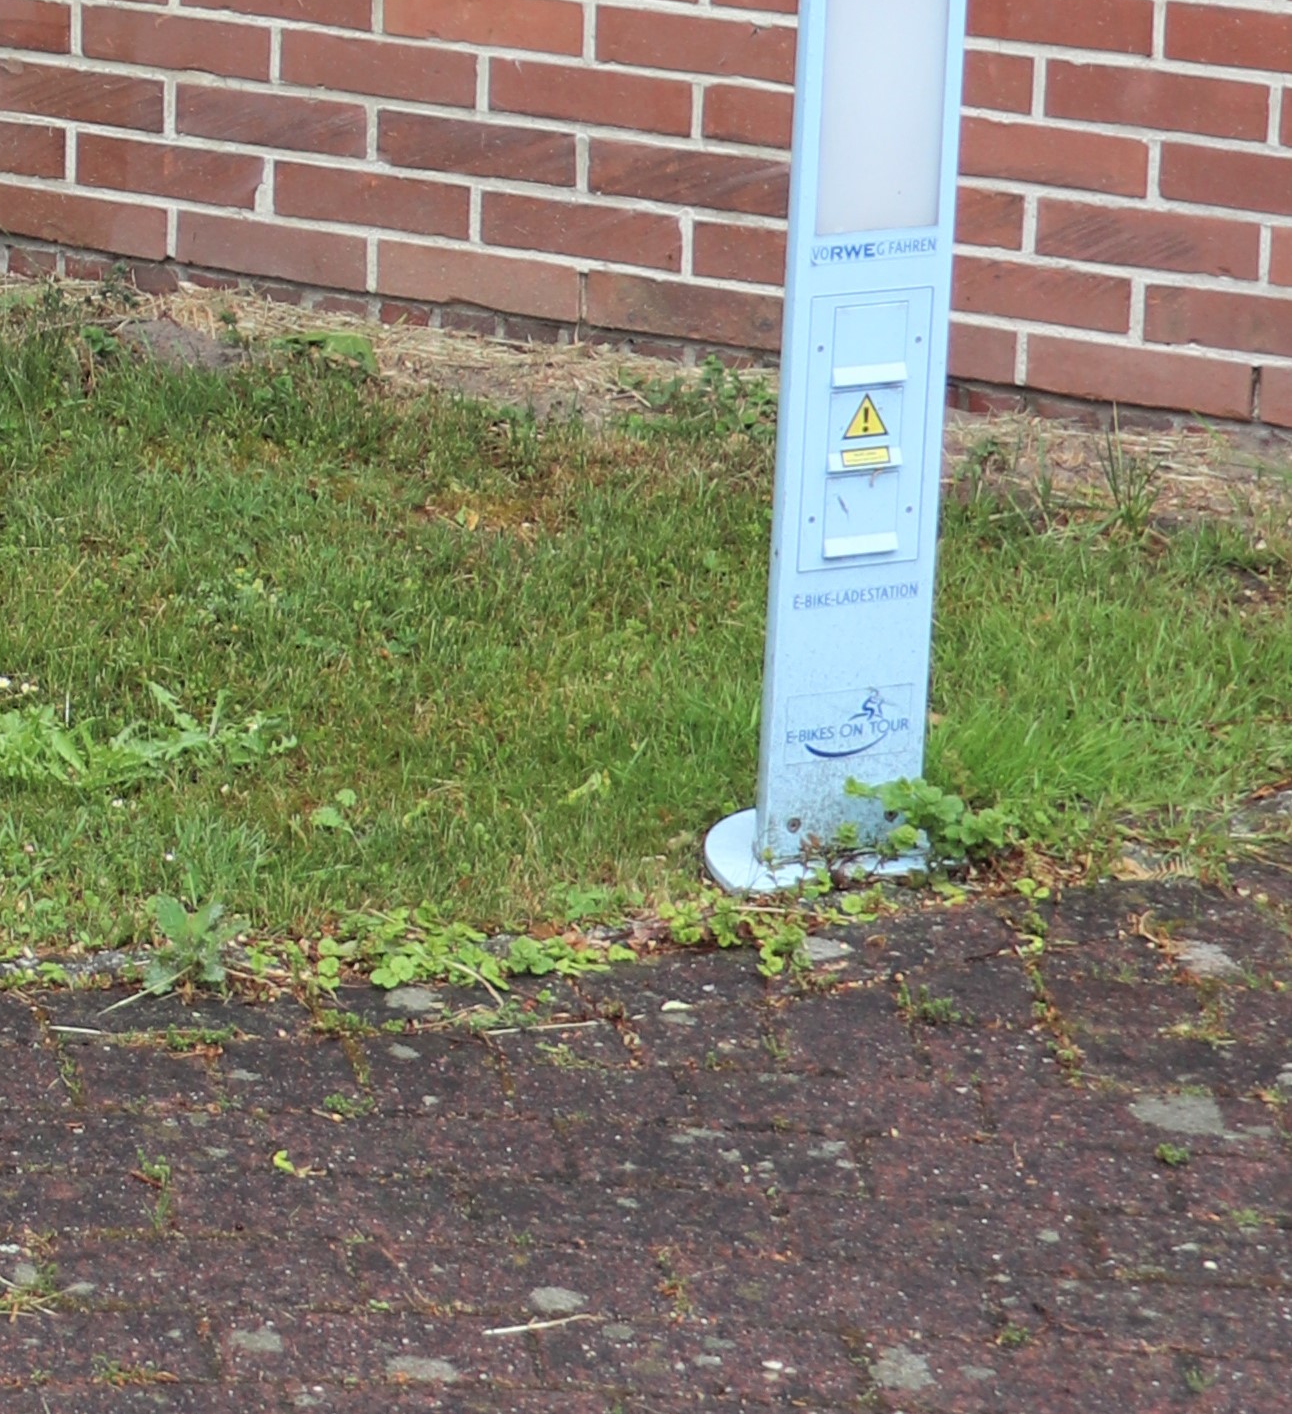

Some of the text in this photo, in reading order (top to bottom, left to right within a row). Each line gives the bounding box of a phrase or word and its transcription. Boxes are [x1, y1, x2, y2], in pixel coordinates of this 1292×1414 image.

[888, 237, 936, 255] FAHREN
[793, 582, 919, 610] E-BIKE-LADESTATION
[786, 718, 909, 744] E-BIKES ON TOUR
